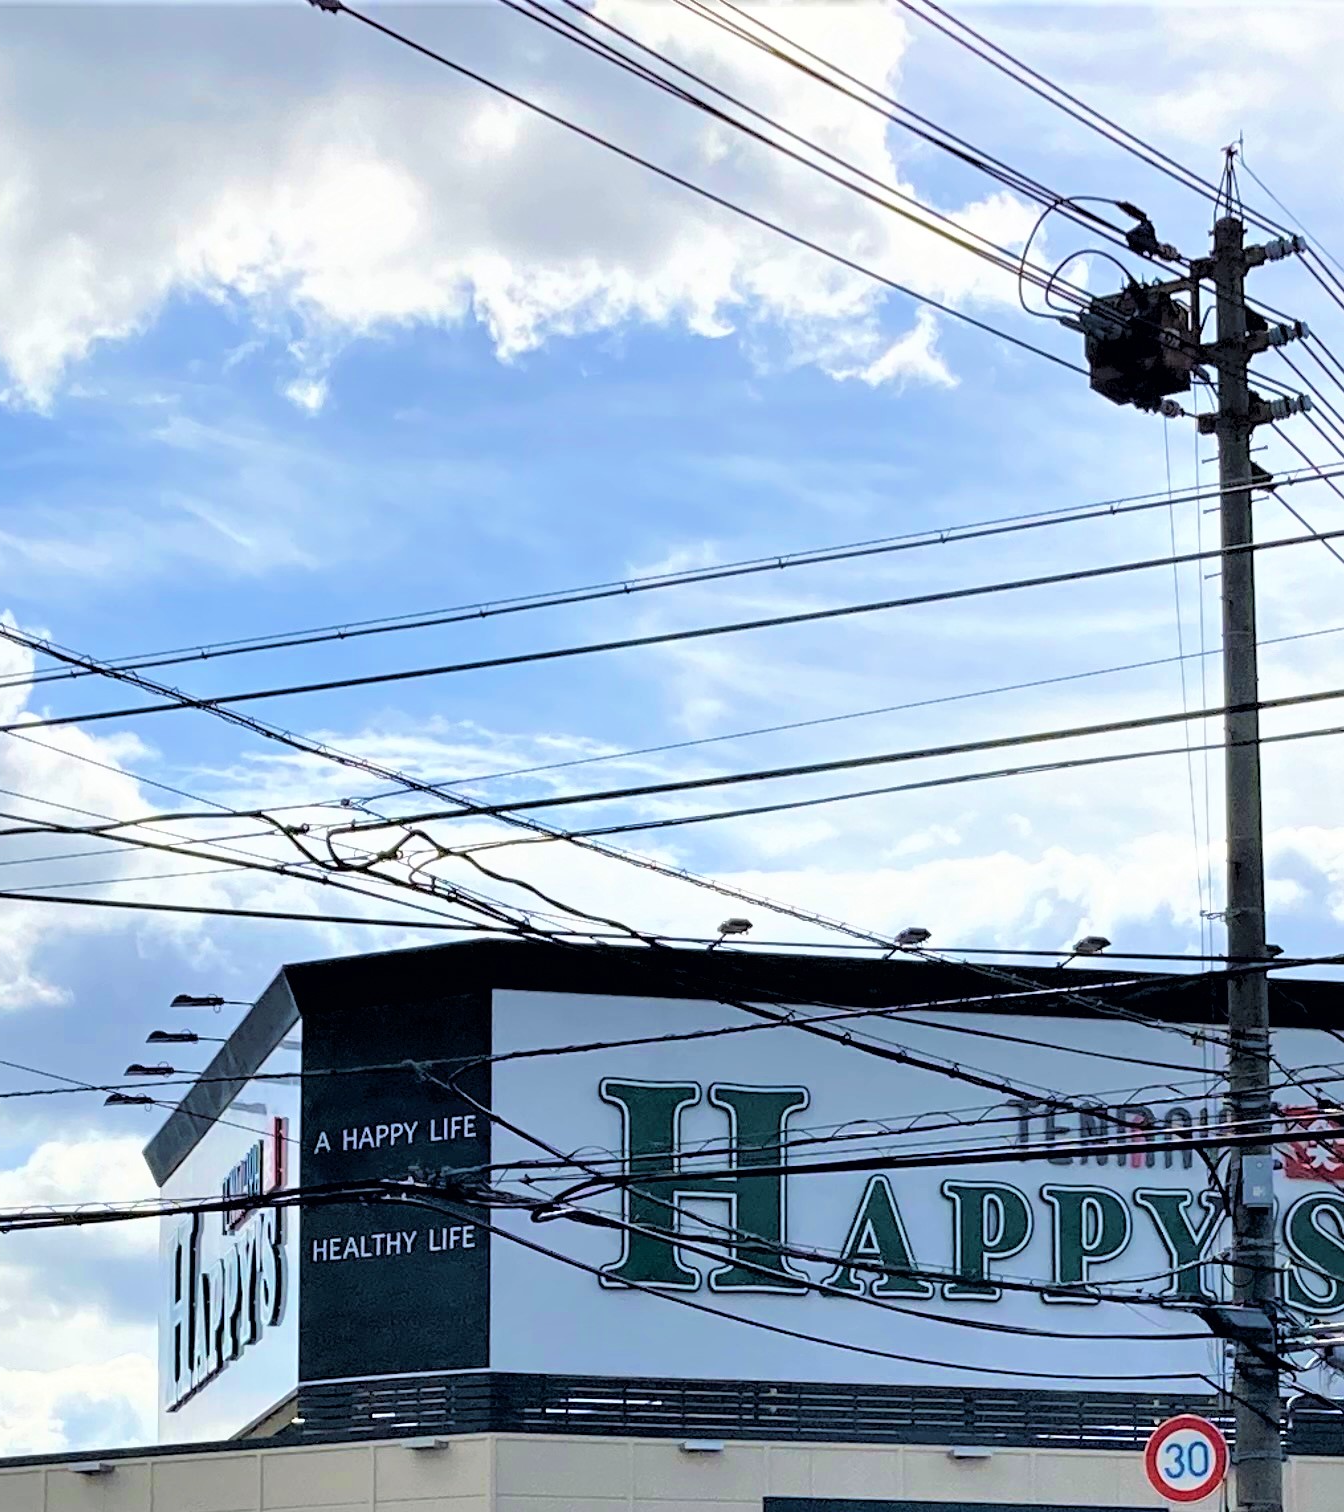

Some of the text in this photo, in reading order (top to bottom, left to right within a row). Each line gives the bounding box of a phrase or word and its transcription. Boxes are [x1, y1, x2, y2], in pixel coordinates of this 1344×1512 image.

[314, 1115, 477, 1154] A HAPPY LIFE
[313, 1225, 476, 1262] HEALTHY LIFE
[1164, 1441, 1209, 1478] 30
